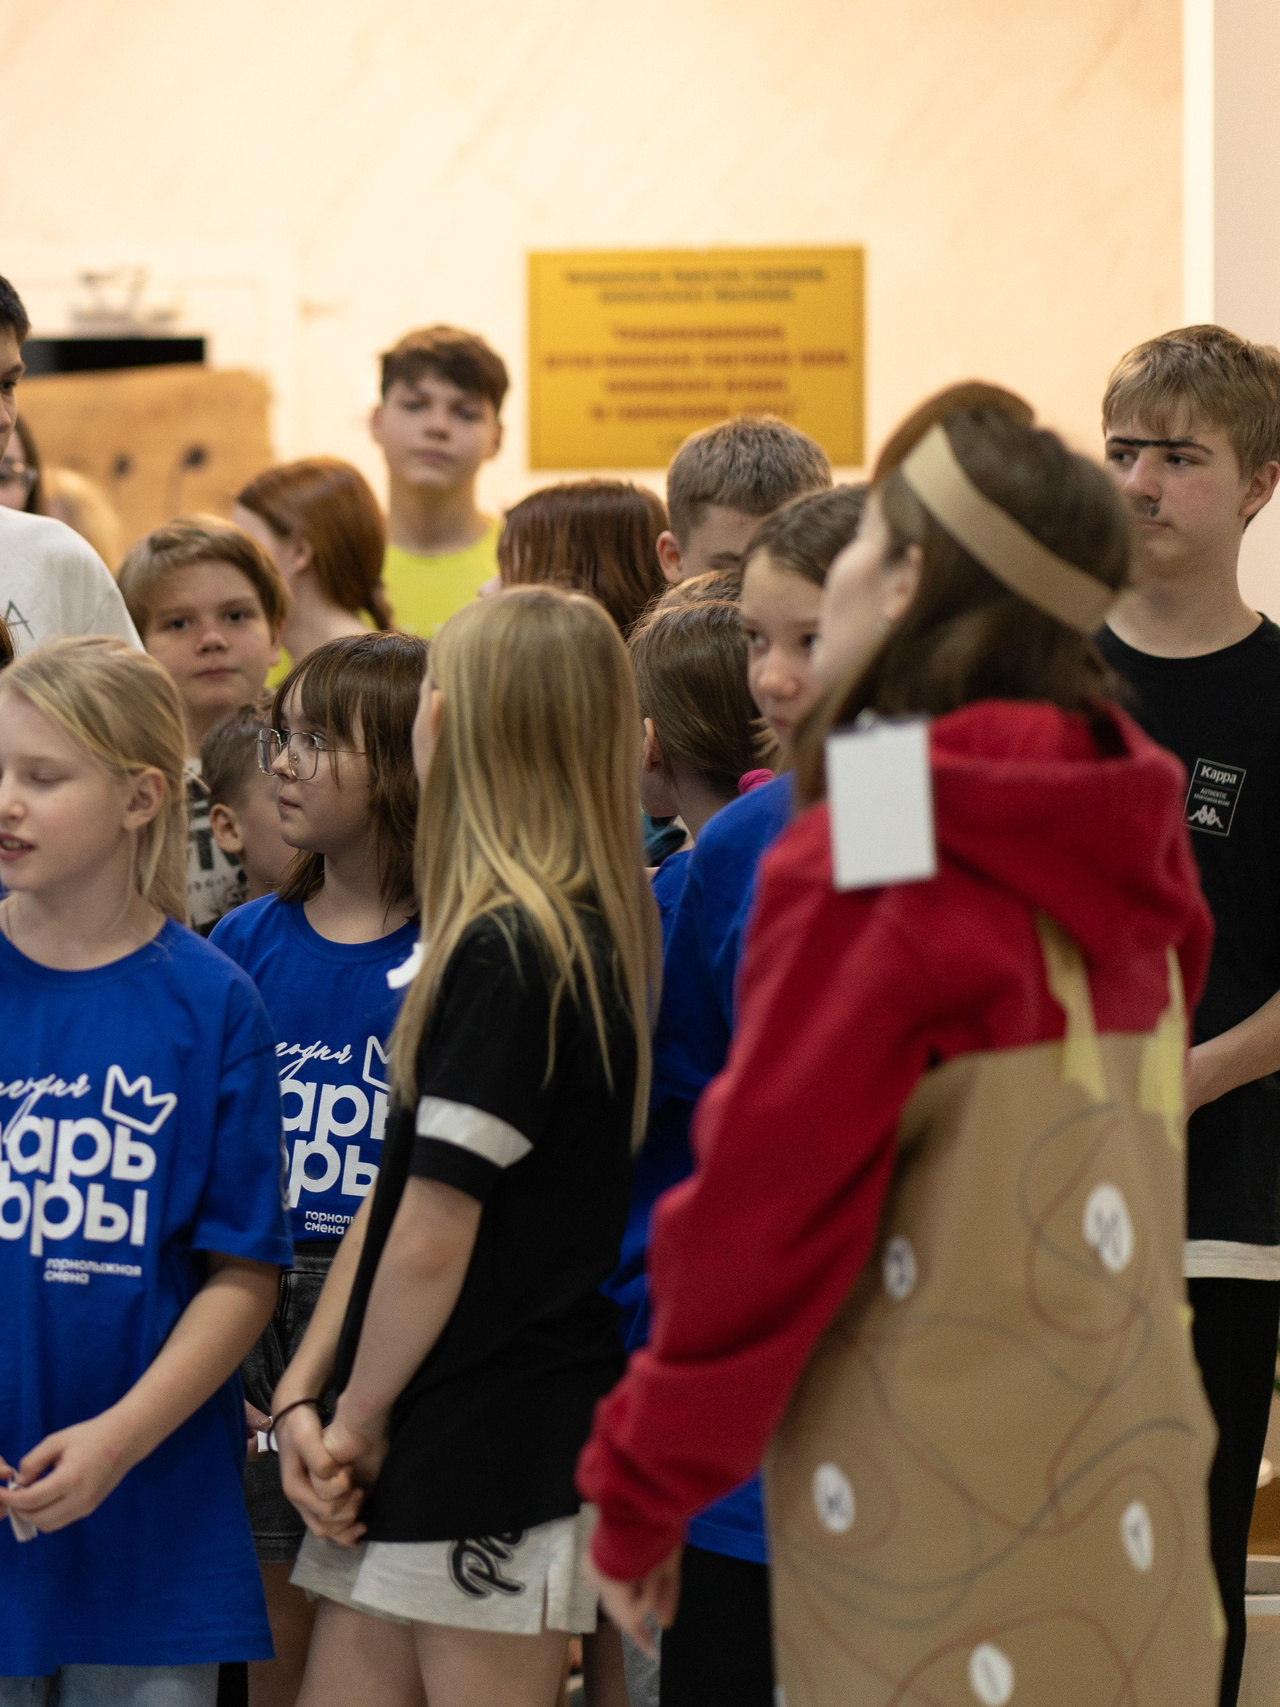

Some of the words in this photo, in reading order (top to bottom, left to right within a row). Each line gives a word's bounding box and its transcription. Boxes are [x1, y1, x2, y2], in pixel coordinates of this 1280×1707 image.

[1200, 765, 1237, 785] Kappa
[304, 1222, 345, 1235] смена
[45, 1257, 142, 1278] горнолыжная
[43, 1270, 90, 1286] смена
